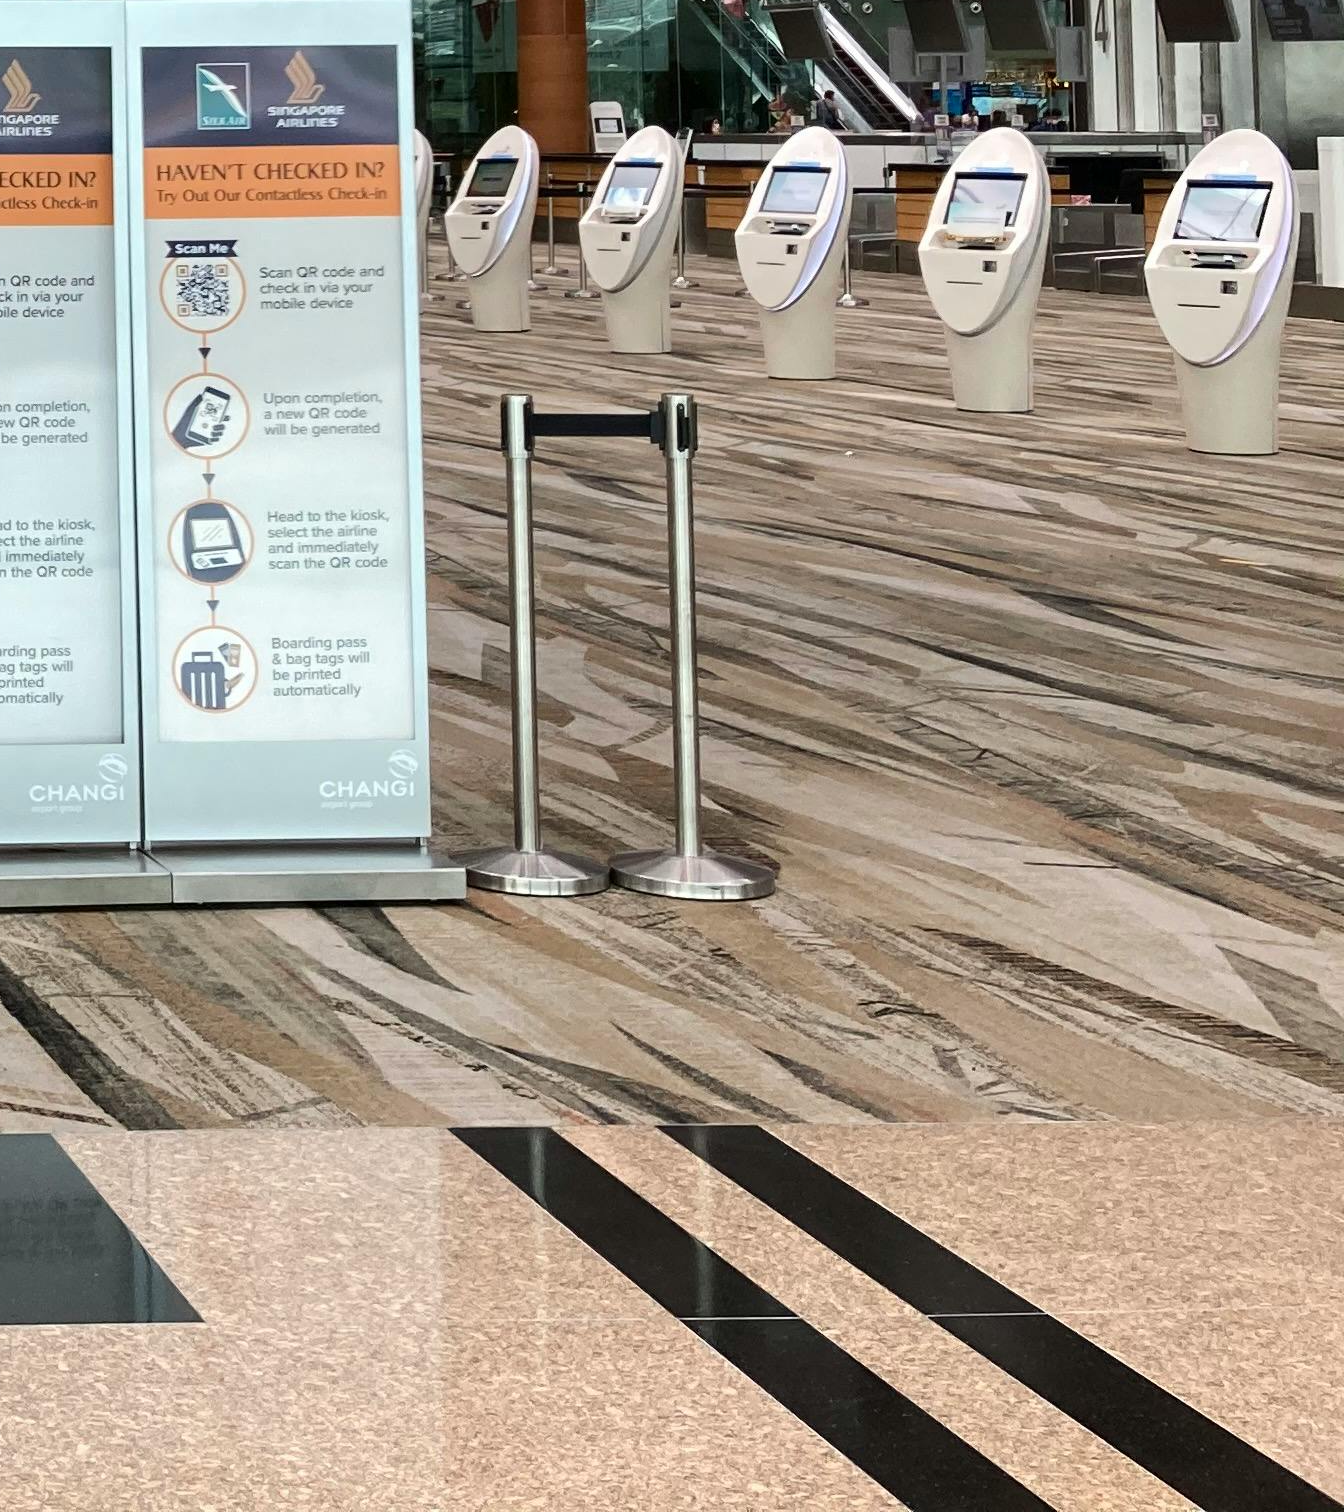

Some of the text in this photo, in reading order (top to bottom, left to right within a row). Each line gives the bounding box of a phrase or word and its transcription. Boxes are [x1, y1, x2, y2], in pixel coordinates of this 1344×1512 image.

[268, 106, 344, 116] SINGAPORE
[276, 118, 338, 127] AIRLINES
[69, 172, 96, 187] IN?
[42, 196, 98, 209] Check-in
[11, 275, 30, 286] QR
[35, 276, 66, 286] code
[71, 276, 94, 286] and
[17, 292, 28, 302] in
[33, 294, 50, 302] via
[55, 294, 83, 304] your
[23, 307, 64, 317] device
[29, 784, 124, 801] CHANGI
[320, 780, 414, 797] CHANGI
